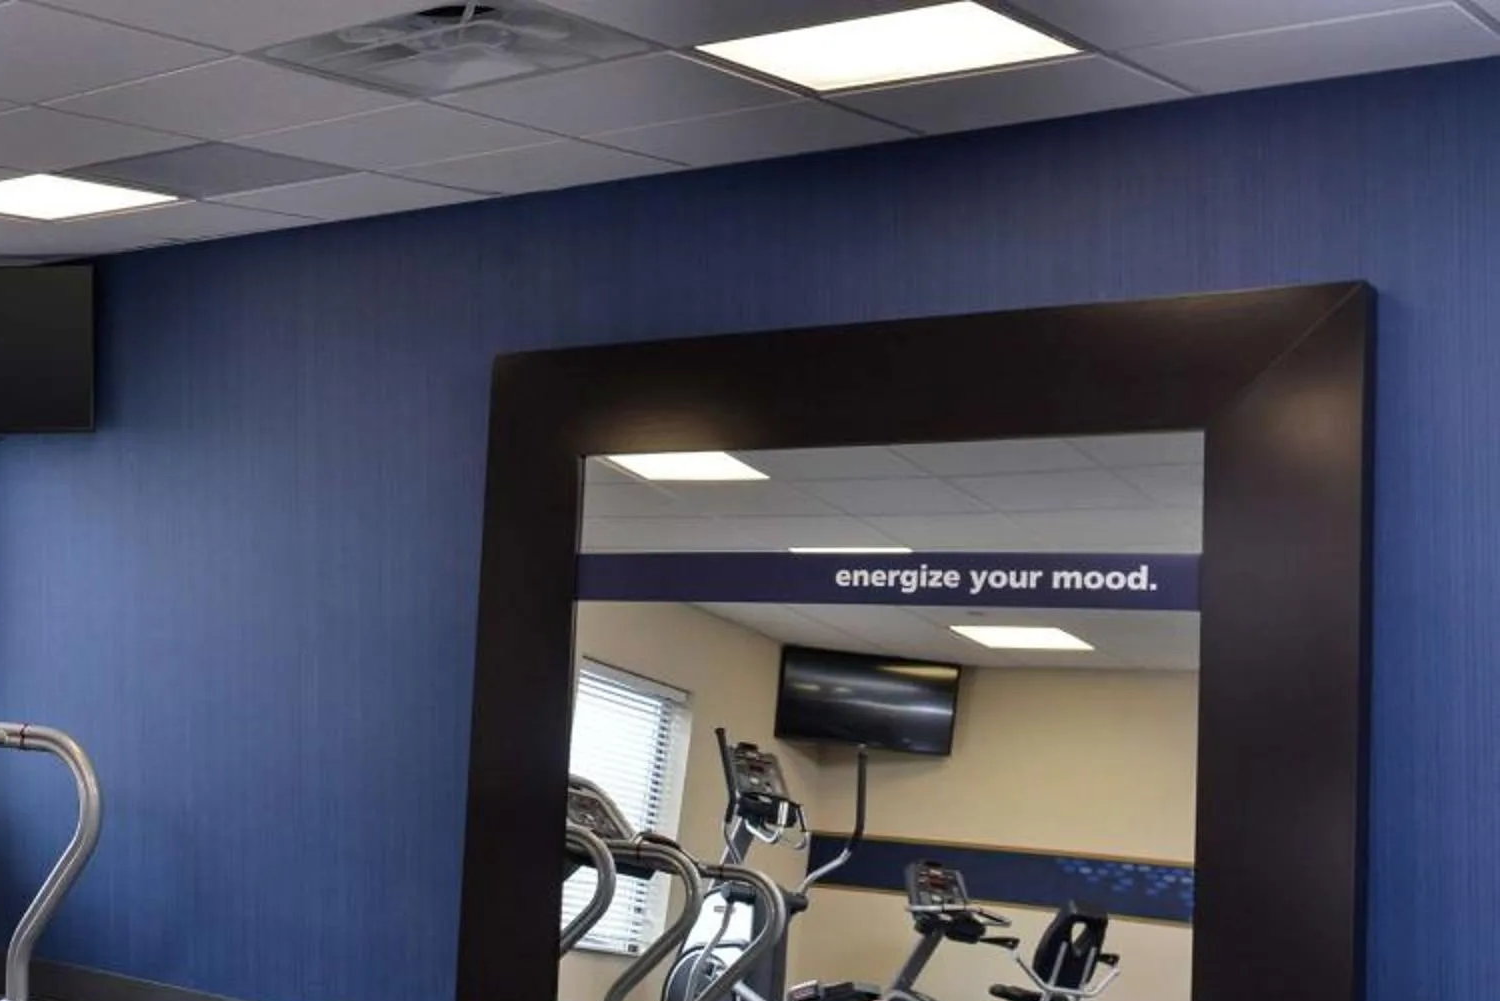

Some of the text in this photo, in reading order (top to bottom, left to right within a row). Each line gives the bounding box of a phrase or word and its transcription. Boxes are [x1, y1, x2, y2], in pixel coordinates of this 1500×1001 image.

[834, 564, 1158, 595] energize your mood.
